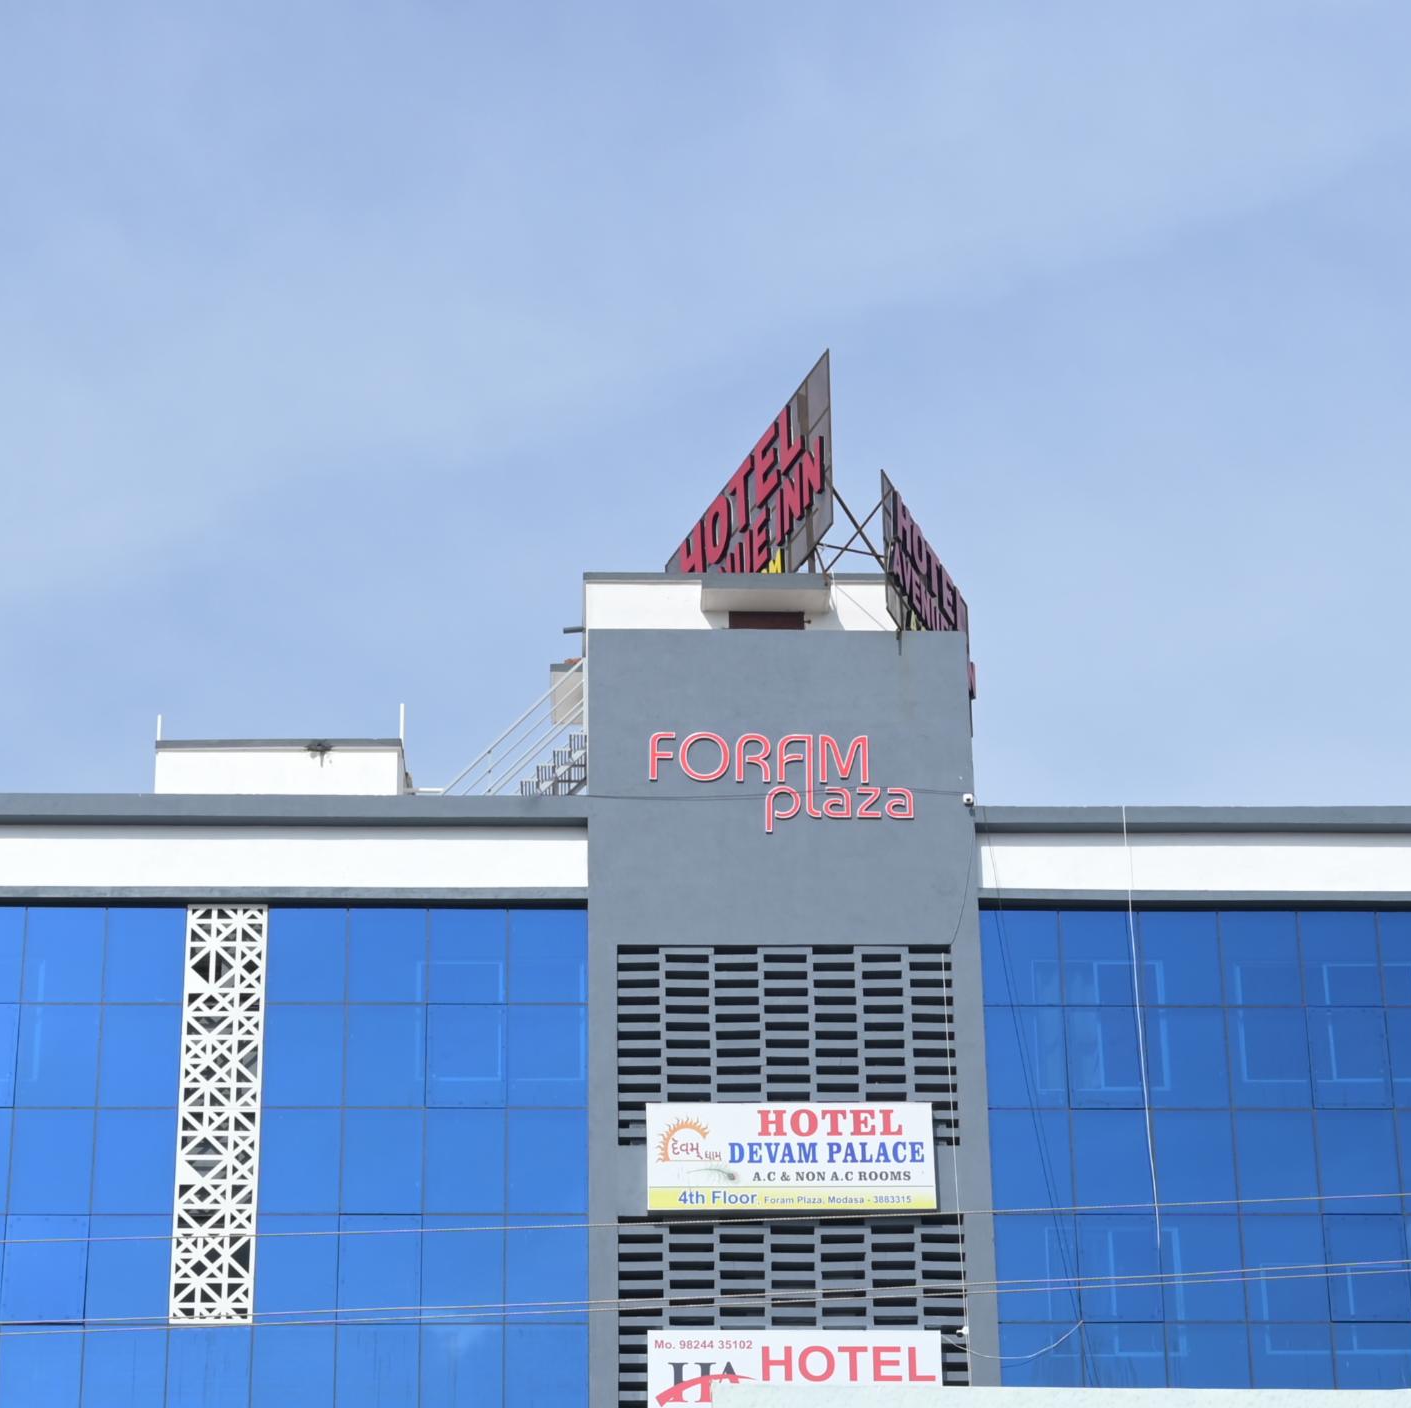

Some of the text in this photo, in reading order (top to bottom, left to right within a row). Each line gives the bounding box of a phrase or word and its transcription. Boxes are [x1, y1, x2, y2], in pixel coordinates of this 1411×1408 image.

[680, 404, 803, 573] HOTEL
[776, 435, 826, 546] INN
[648, 731, 870, 784] FORAM
[765, 784, 915, 833] plaza
[757, 1108, 903, 1136] HOTEL
[728, 1141, 925, 1163] DEVAM PALACE
[753, 1170, 912, 1182] A.C & NON A.C ROOMS
[678, 1191, 705, 1204] 4th
[764, 1196, 794, 1204] Foram
[828, 1196, 865, 1204] Modasa
[654, 1340, 753, 1350] Mo. 98244 35102
[761, 1345, 936, 1382] HOTEL
